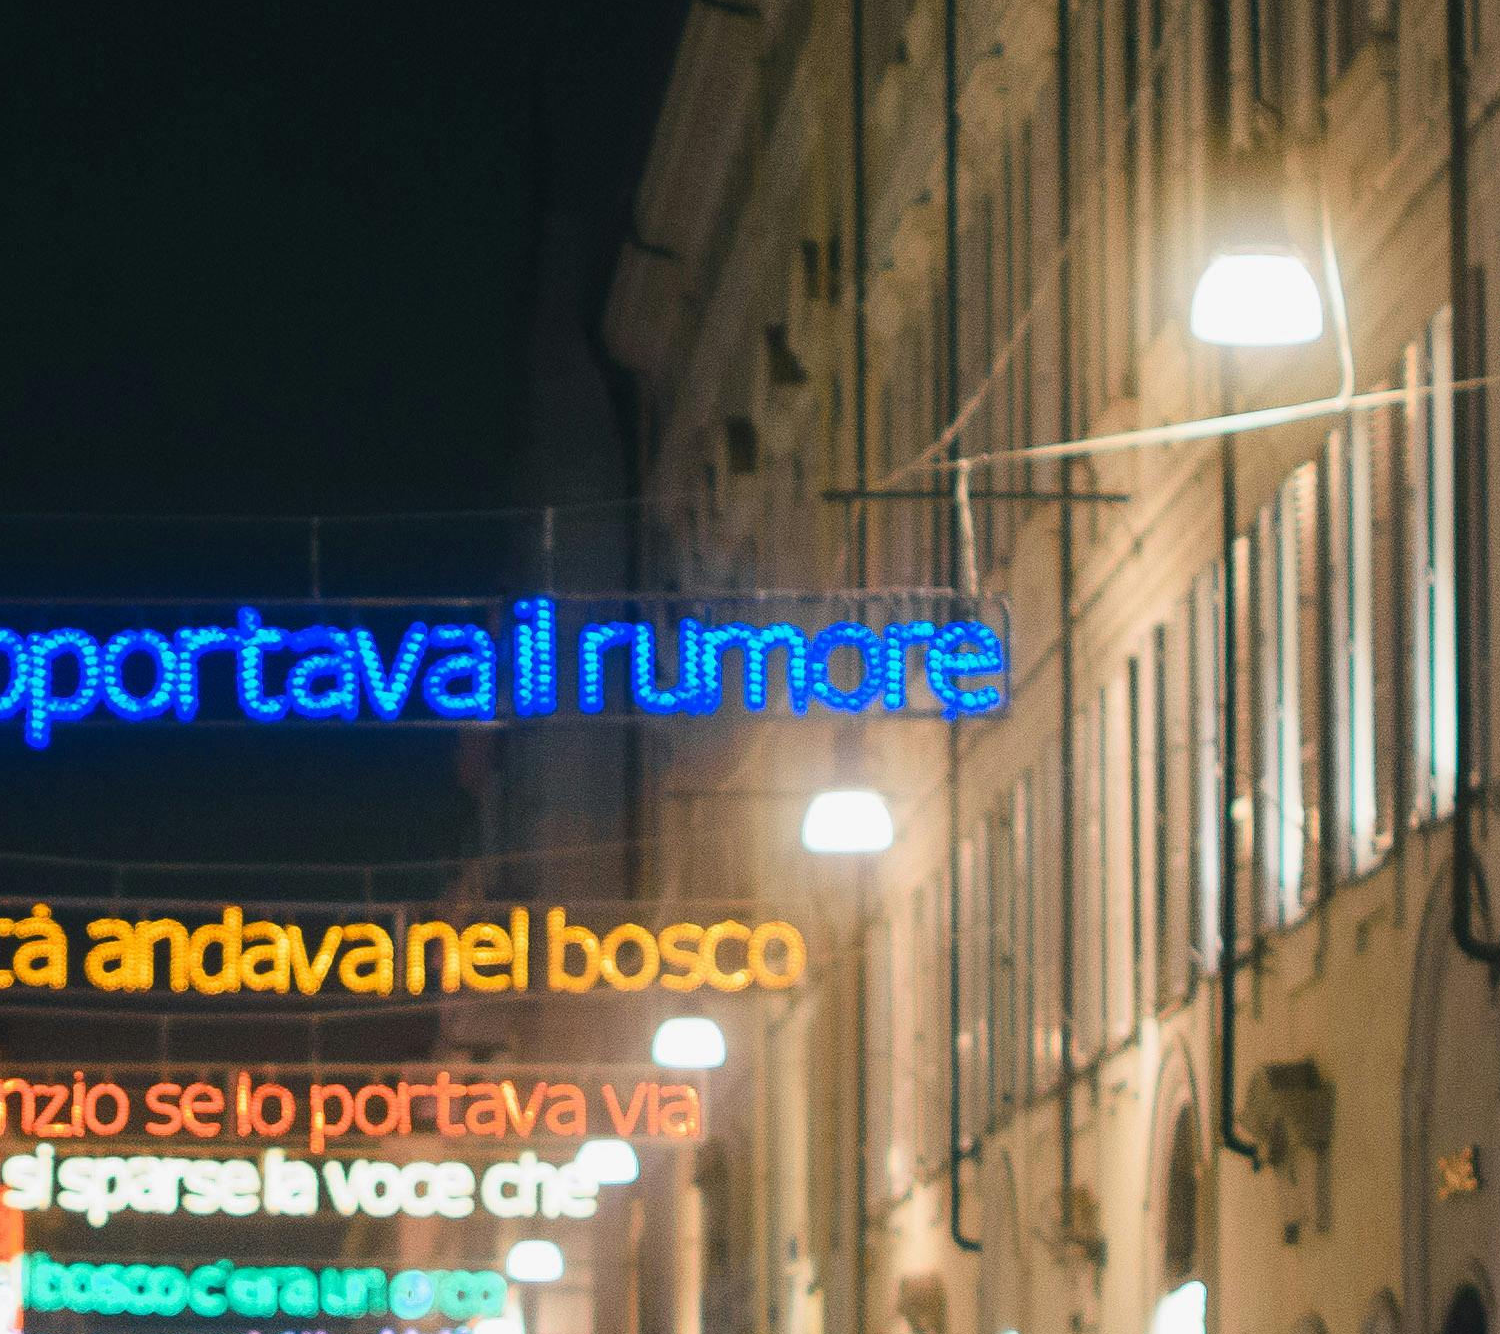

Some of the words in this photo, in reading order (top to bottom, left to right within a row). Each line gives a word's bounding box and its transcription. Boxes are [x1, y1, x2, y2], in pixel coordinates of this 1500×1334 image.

[511, 594, 557, 717] il
[578, 618, 1003, 722] rumore
[86, 905, 393, 997] andava
[407, 905, 528, 995] nel
[547, 903, 807, 994] bosco
[143, 1081, 225, 1138] se
[236, 1069, 296, 1139] lo
[309, 1069, 588, 1155] portava
[600, 1079, 703, 1139] via
[2, 1142, 55, 1210] si
[57, 1151, 260, 1227] sparse
[263, 1147, 319, 1215] la
[323, 1159, 475, 1219] voce
[481, 1151, 600, 1219] che
